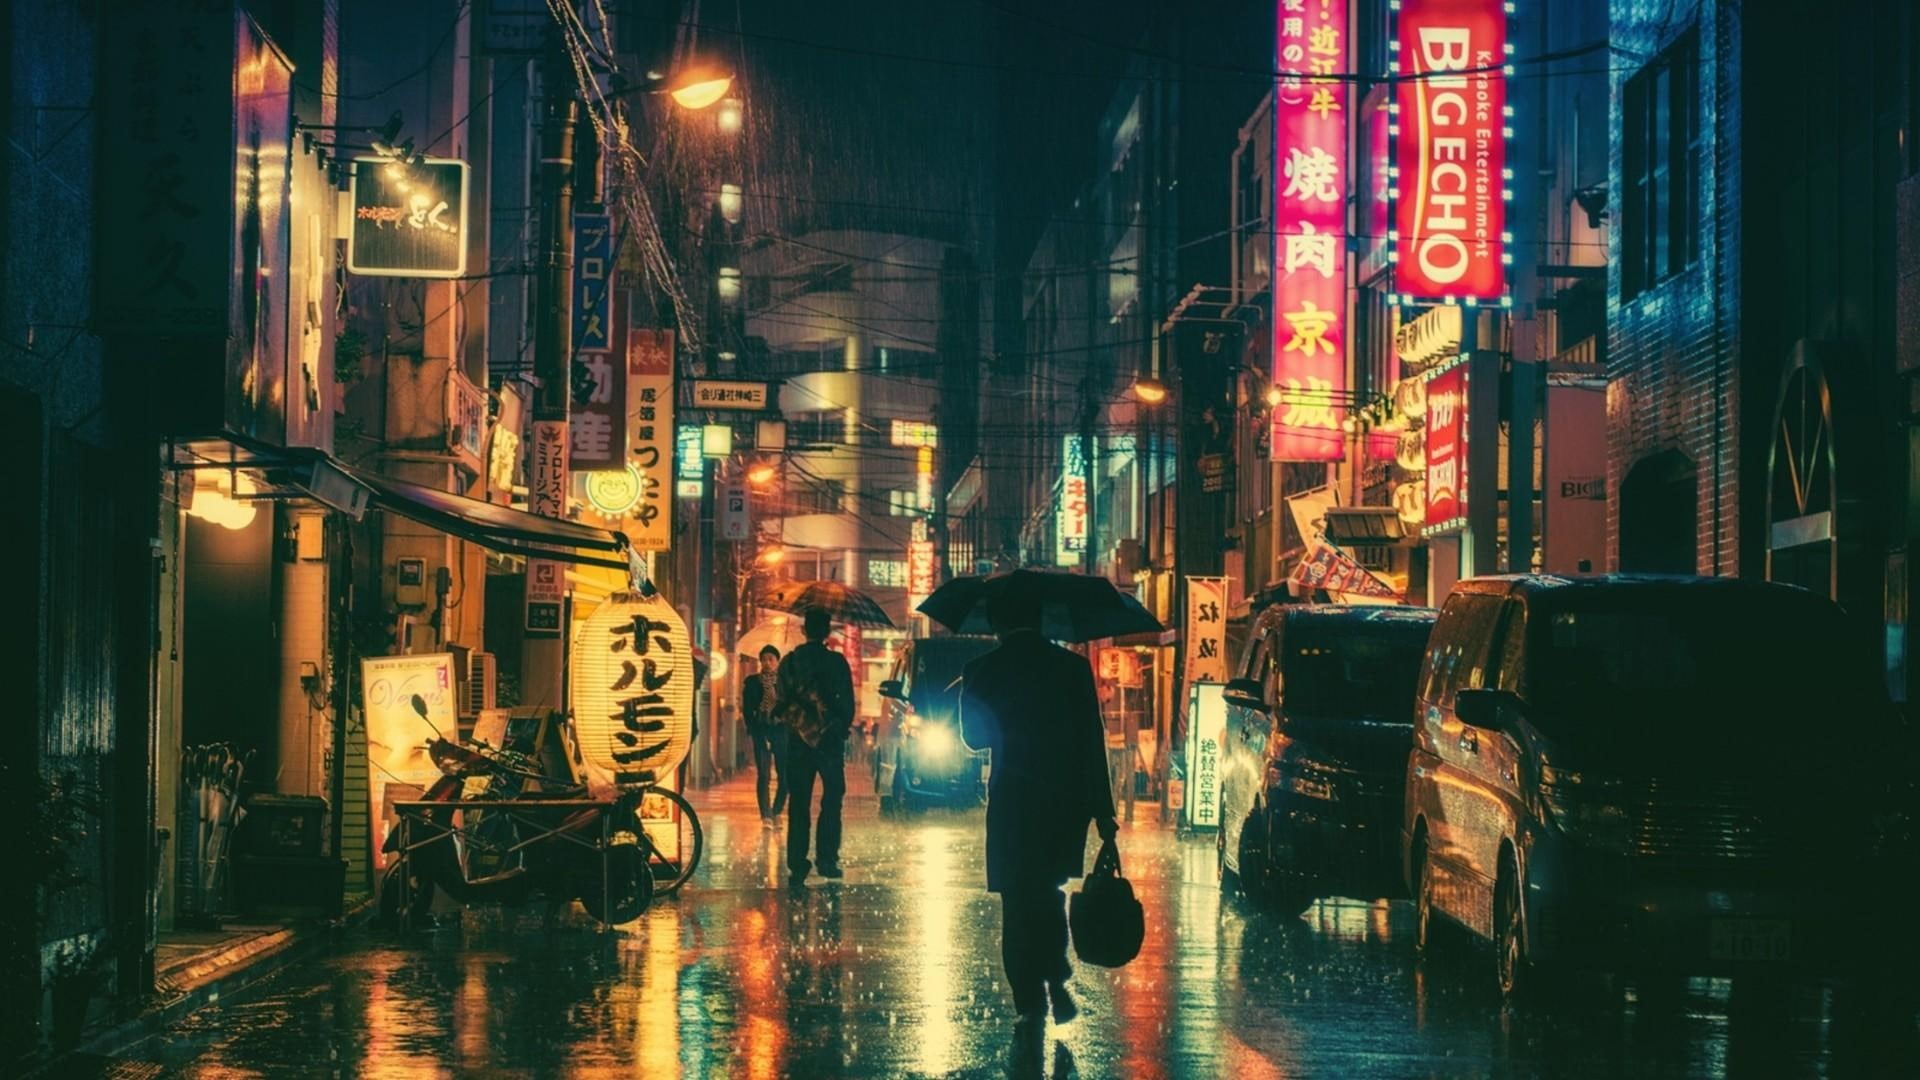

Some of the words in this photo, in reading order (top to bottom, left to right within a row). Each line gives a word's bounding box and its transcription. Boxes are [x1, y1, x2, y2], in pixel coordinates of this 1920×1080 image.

[1475, 51, 1492, 122] Karaoke
[1475, 128, 1492, 258] Entertainment
[582, 224, 608, 340] プロレス
[610, 615, 674, 764] ホルモン
[1200, 738, 1217, 823] 絶賛営業中
